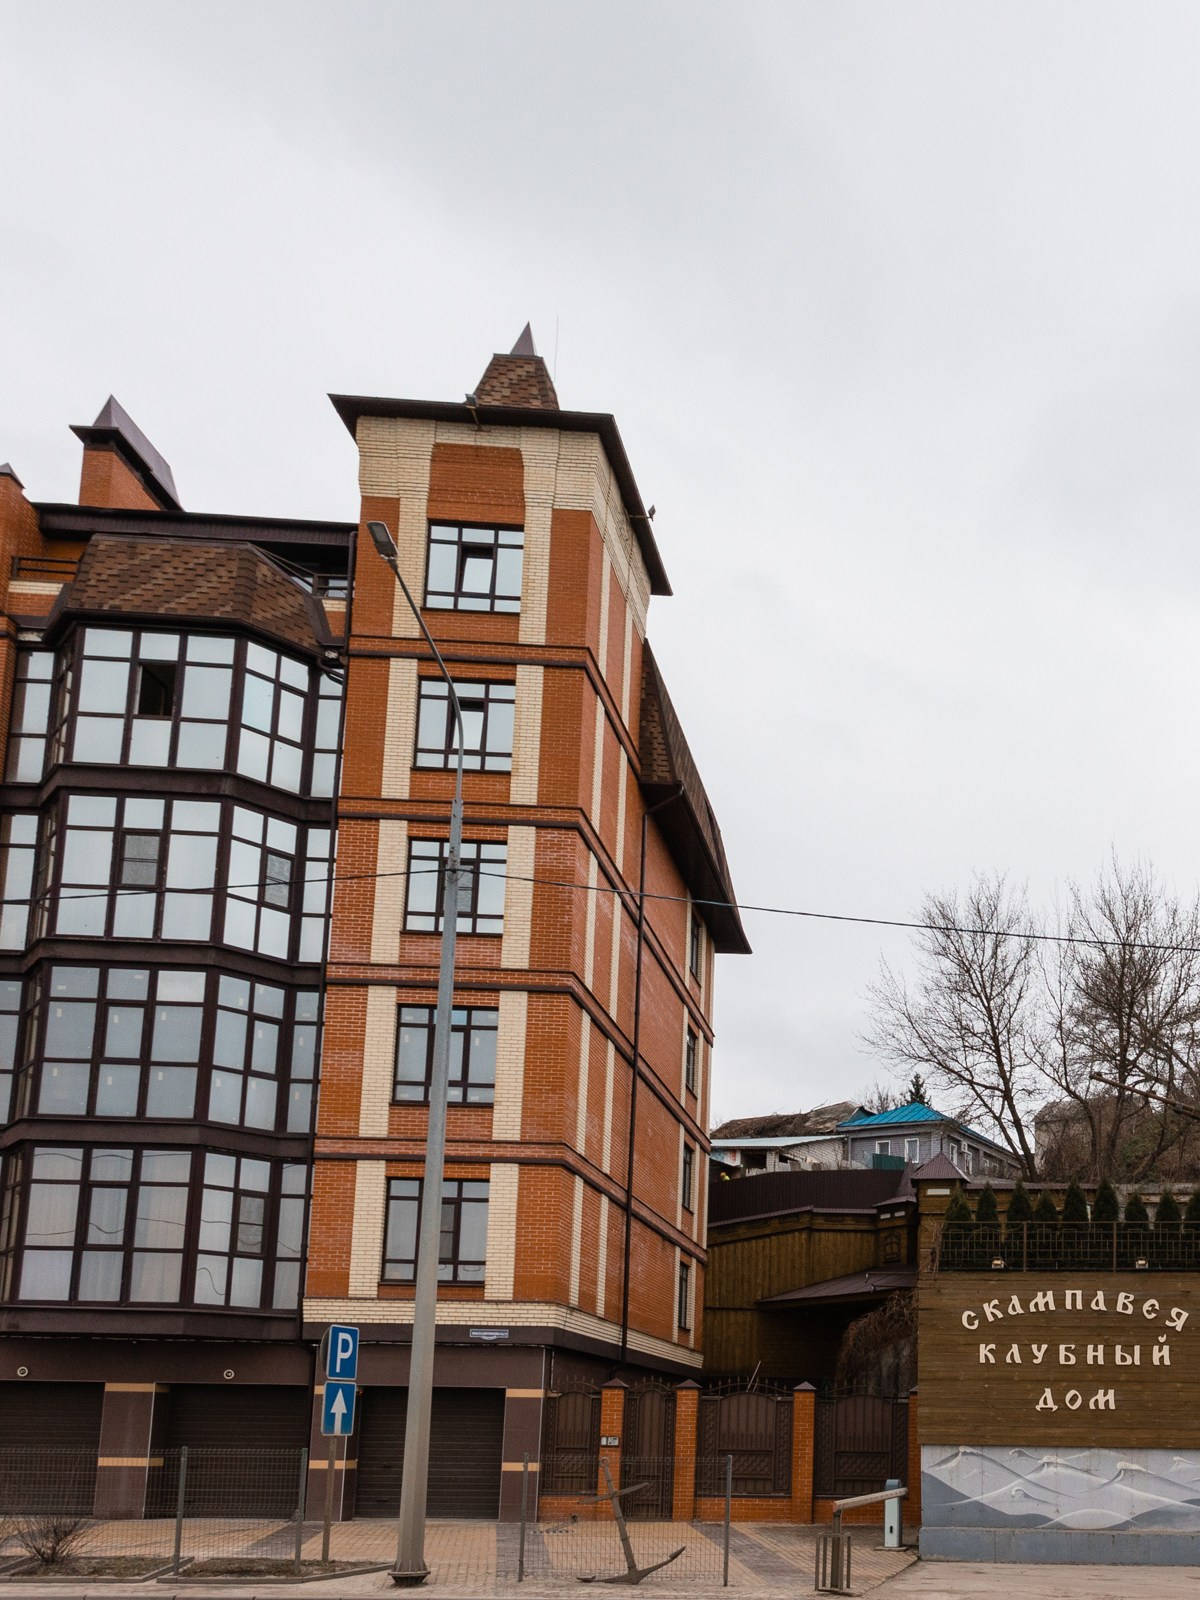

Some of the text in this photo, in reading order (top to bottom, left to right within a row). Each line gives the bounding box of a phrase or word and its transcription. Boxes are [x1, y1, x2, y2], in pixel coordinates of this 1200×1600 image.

[335, 1332, 353, 1373] P
[979, 1333, 1171, 1366] КЛУБНЫЙ
[1035, 1387, 1116, 1412] ДОМ
